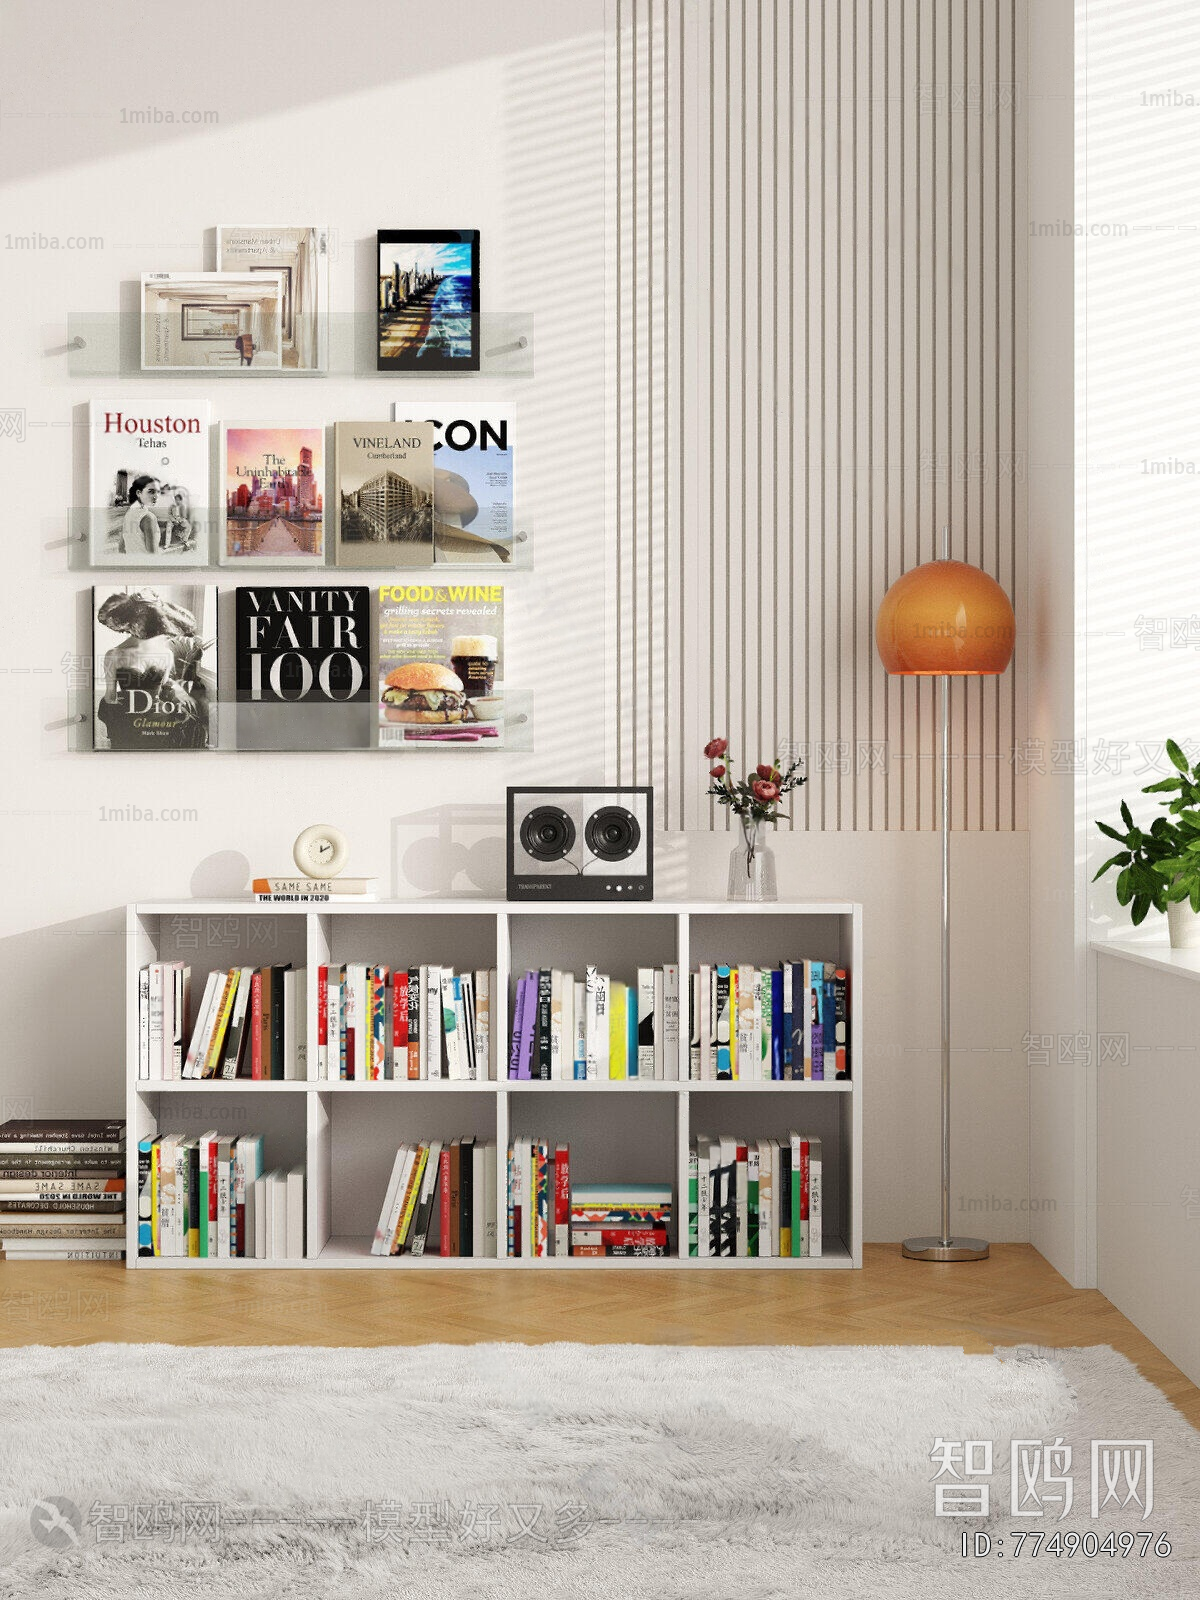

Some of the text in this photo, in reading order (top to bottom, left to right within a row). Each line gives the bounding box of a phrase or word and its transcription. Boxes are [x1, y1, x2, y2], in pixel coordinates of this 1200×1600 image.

[104, 412, 201, 434] Houston
[137, 437, 167, 448] Tehas
[353, 437, 421, 449] VINELAND
[263, 454, 286, 465] The
[247, 591, 360, 612] VANITY
[384, 605, 497, 617] grilling secrets revealed
[246, 615, 363, 649] FAIR
[125, 689, 184, 714] Dior
[133, 718, 178, 729] Glamour
[274, 882, 333, 892] SAME SAME
[258, 894, 329, 902] THE WORLD IN 2020
